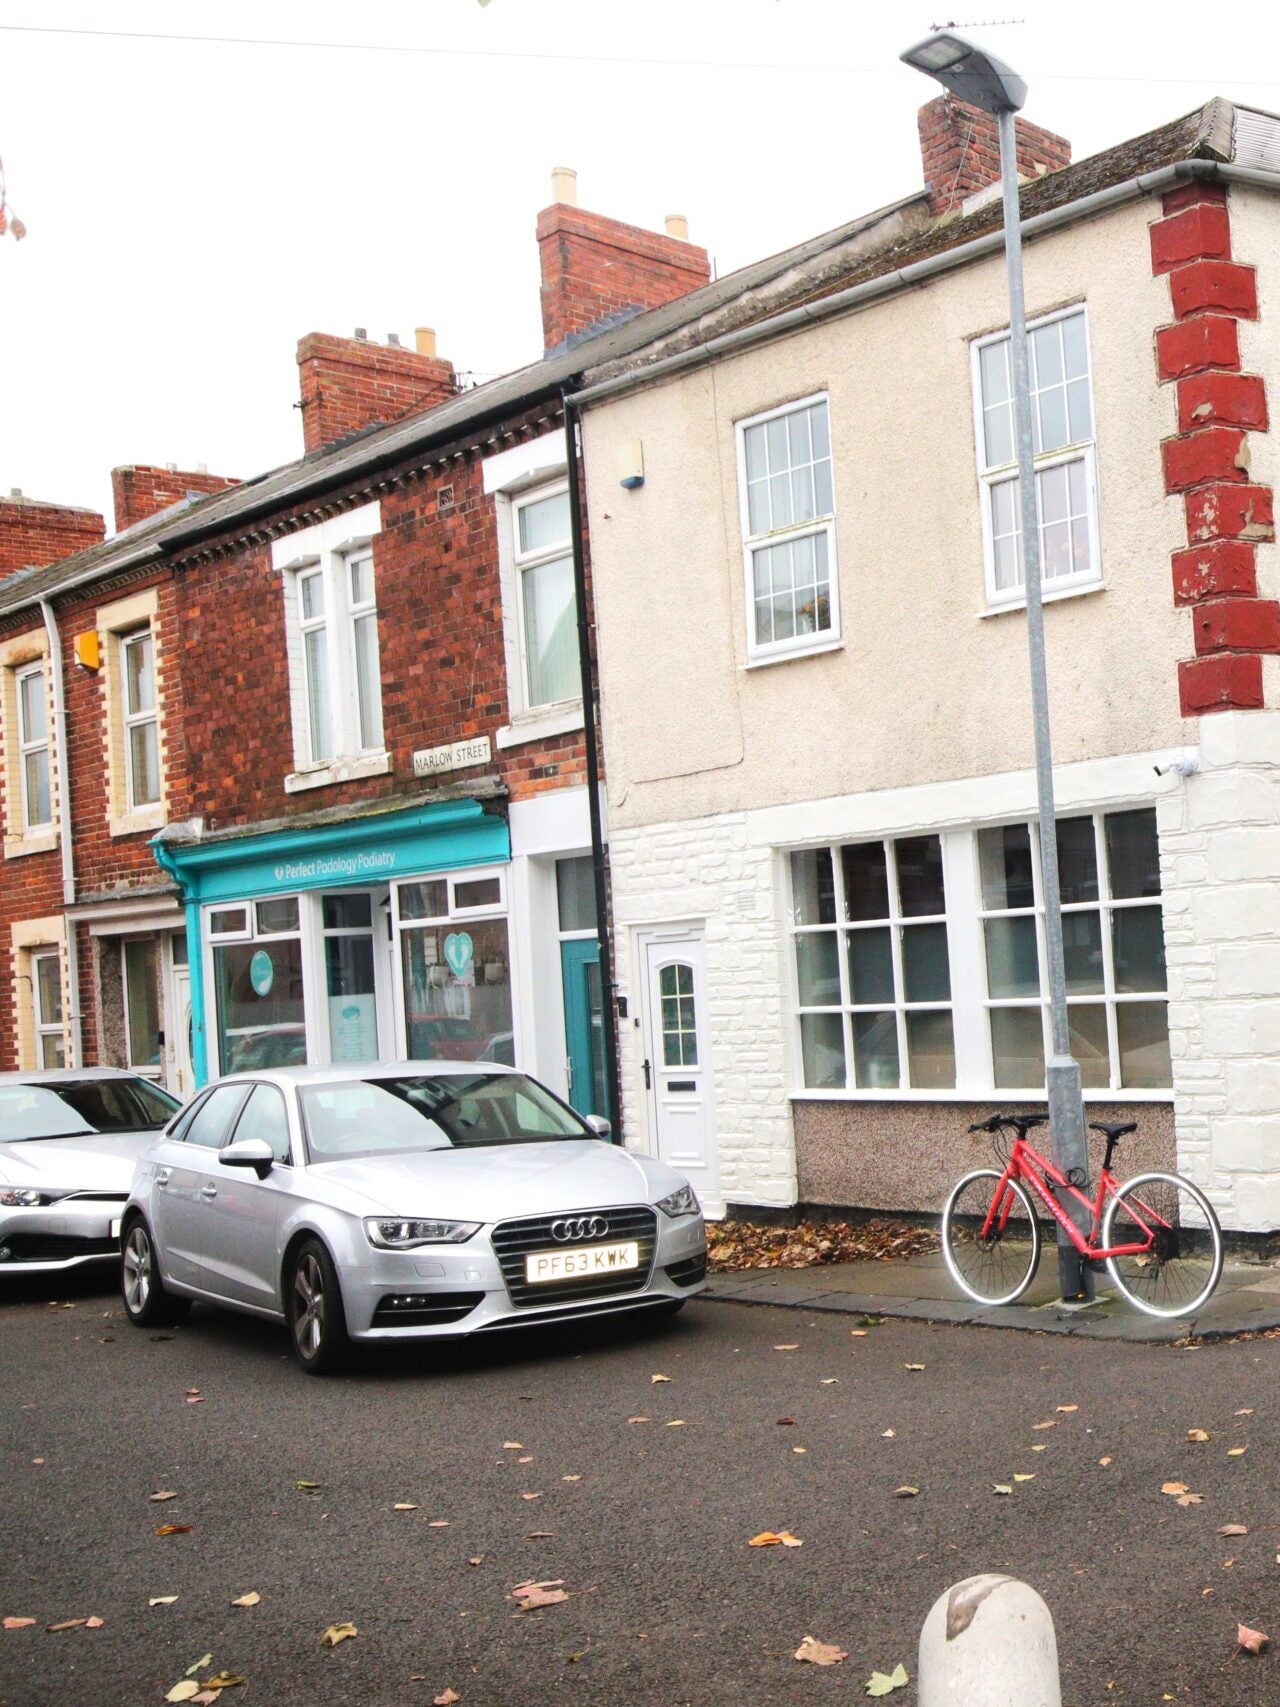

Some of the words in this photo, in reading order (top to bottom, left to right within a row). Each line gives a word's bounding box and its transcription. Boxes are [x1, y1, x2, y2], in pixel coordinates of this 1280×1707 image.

[414, 750, 453, 771] MARLOW
[457, 743, 489, 761] STREET
[285, 862, 316, 879] Perfect
[316, 857, 358, 874] Podology
[358, 851, 396, 868] Podiatry
[537, 1253, 588, 1276] PF63
[594, 1248, 629, 1268] KWK
